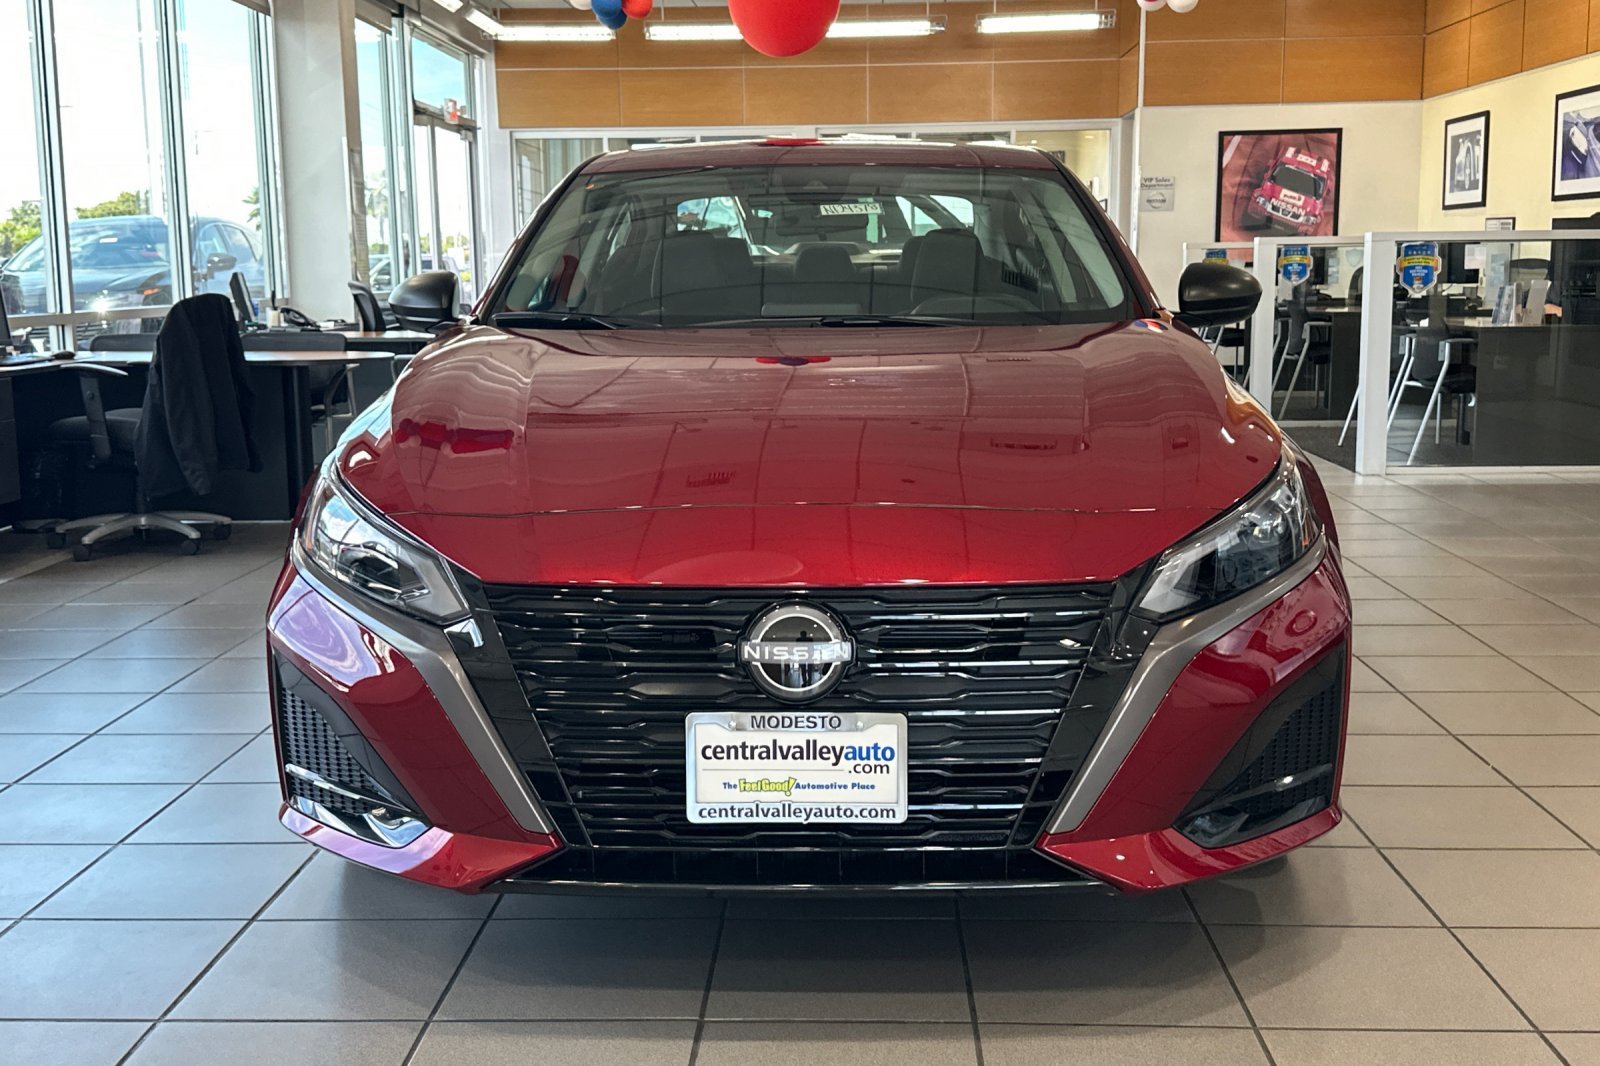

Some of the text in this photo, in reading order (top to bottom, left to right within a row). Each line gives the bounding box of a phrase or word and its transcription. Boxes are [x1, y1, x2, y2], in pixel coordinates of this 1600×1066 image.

[1270, 197, 1306, 216] NISSAN
[750, 715, 842, 729] MODESTO
[701, 738, 896, 767] centralvalleyauto
[848, 763, 890, 775] .com
[722, 782, 738, 790] The
[794, 781, 849, 791] Automotive
[851, 782, 876, 790] Place
[698, 802, 897, 822] centralvalleyauto.com
